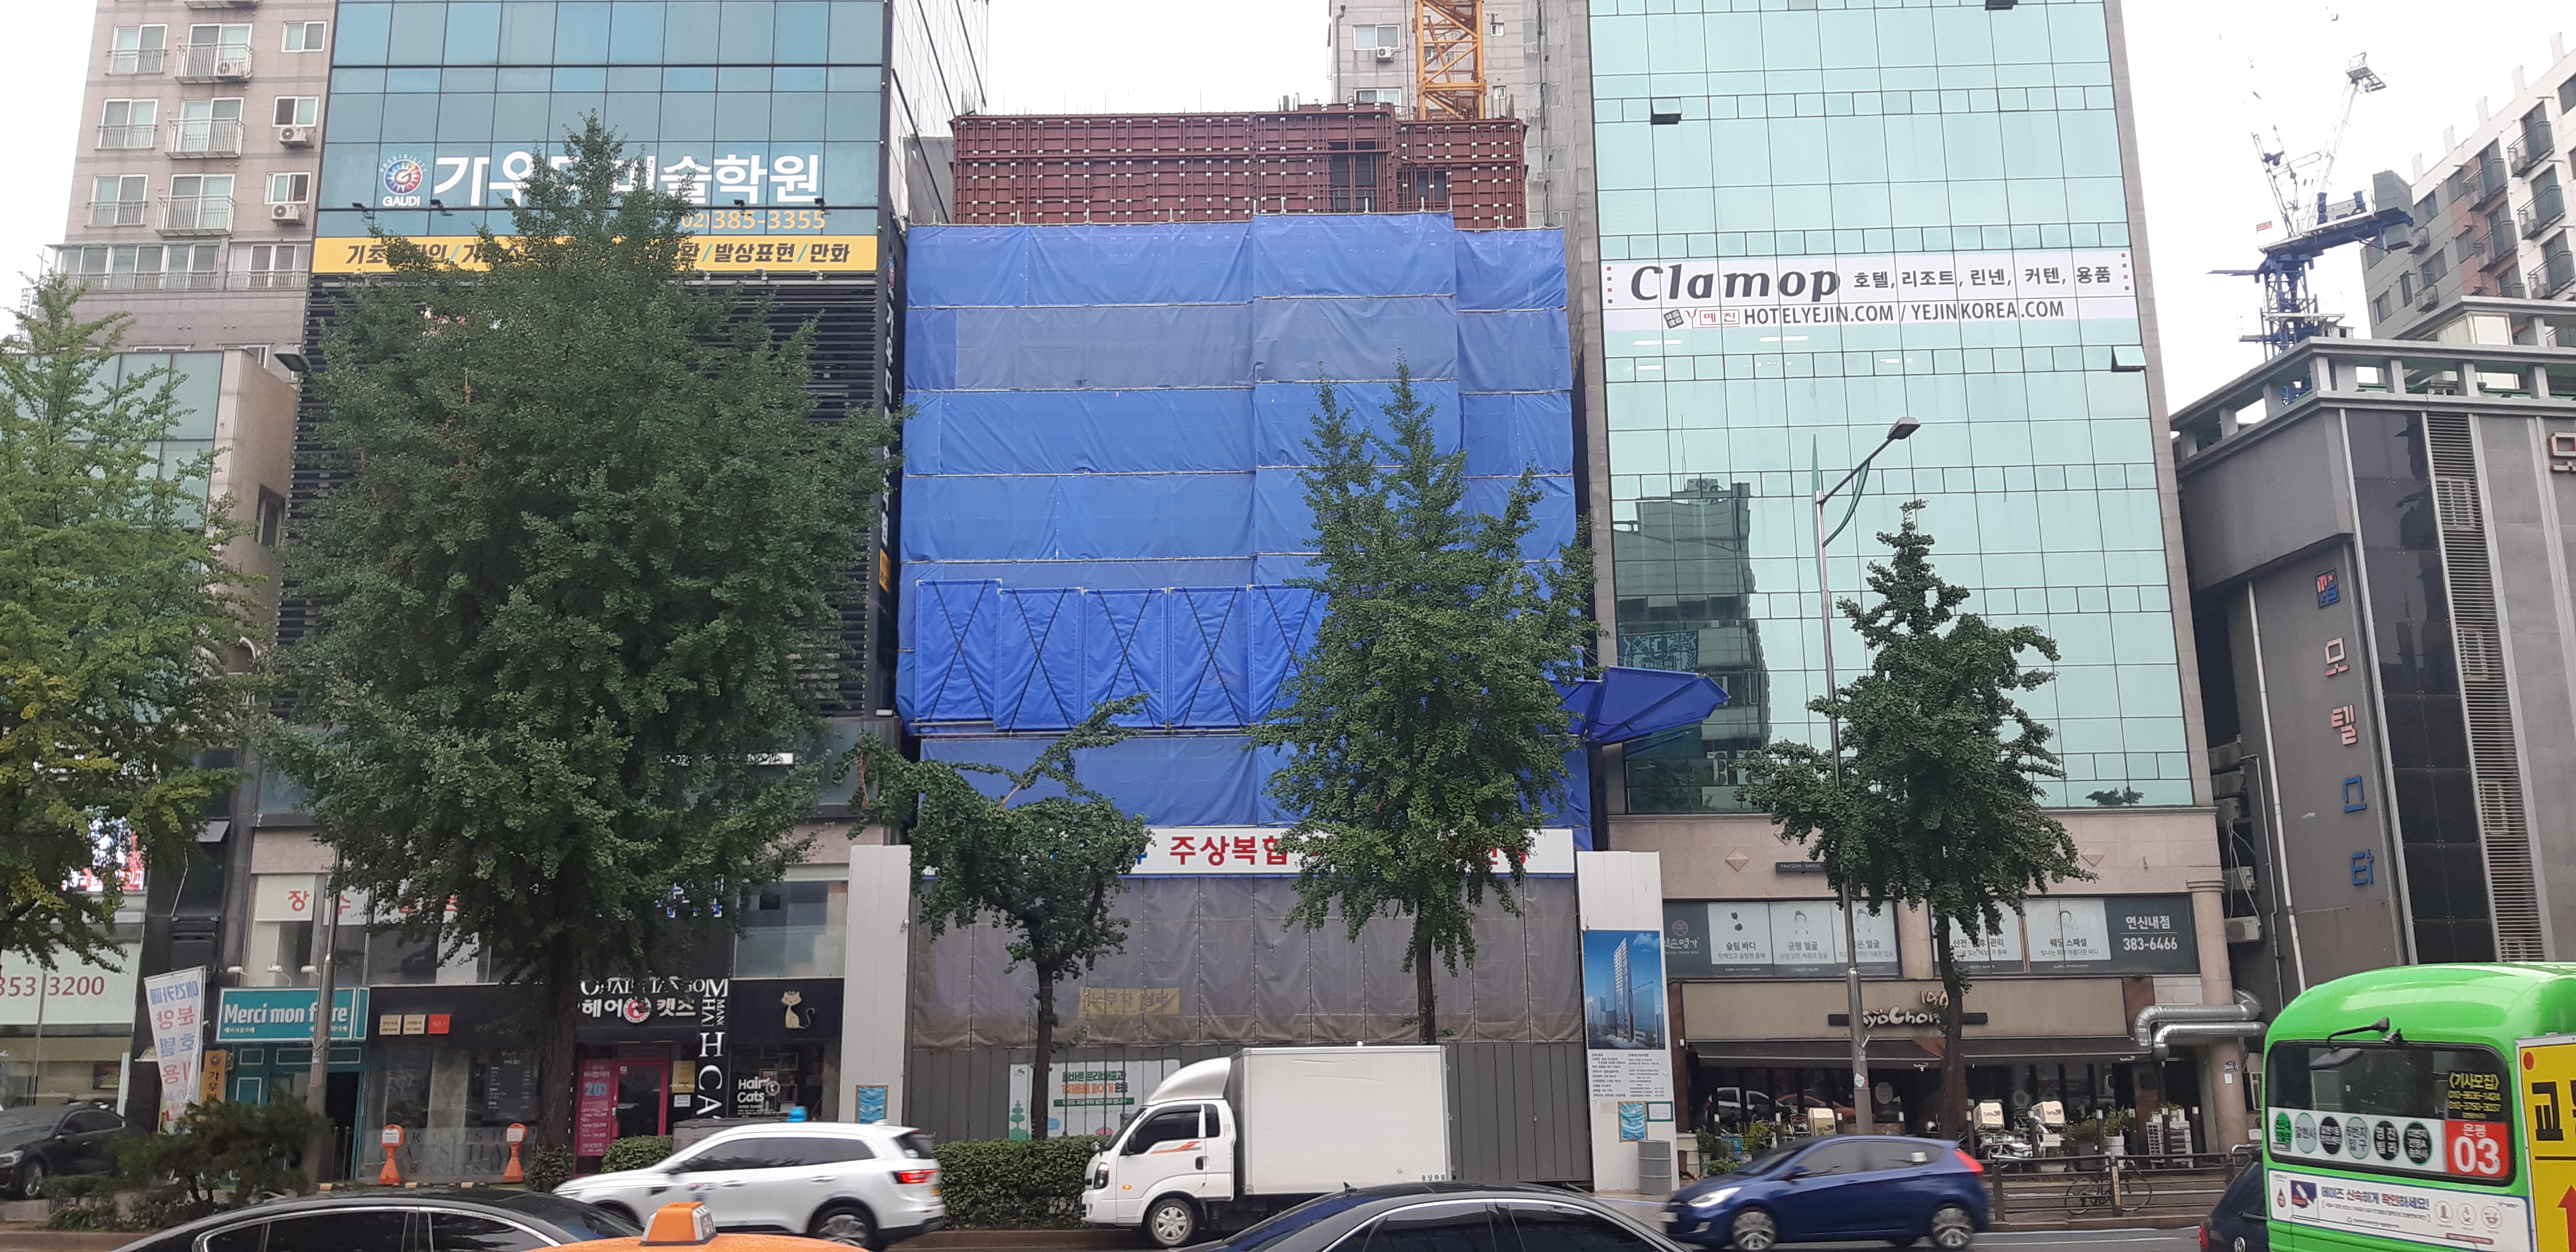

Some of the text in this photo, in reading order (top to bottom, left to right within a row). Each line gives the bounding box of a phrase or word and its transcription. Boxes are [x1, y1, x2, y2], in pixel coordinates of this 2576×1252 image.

[382, 196, 420, 207] GAUDI
[1631, 264, 1840, 302] Clamop
[1854, 266, 2111, 290] 호텔, 리조트, 린넨, 커텐, 용품
[1744, 305, 1894, 324] HOTELYEJIN.COM
[1911, 301, 2064, 320] YEJINKOREA.COM
[2125, 914, 2171, 931] 연신내점
[1742, 941, 1756, 951] 바디
[1803, 941, 1817, 951] 얼굴
[1990, 938, 2004, 947] 관리
[2049, 937, 2087, 947] 웨딩 스페셜
[2123, 936, 2178, 951] 383-6466
[48, 976, 105, 996] 3200
[224, 1003, 268, 1024] Merci
[270, 1007, 305, 1023] mon
[581, 998, 623, 1018] 헤어
[738, 1076, 770, 1089] Hair
[737, 1091, 765, 1103] Cats
[2454, 1136, 2501, 1174] 03
